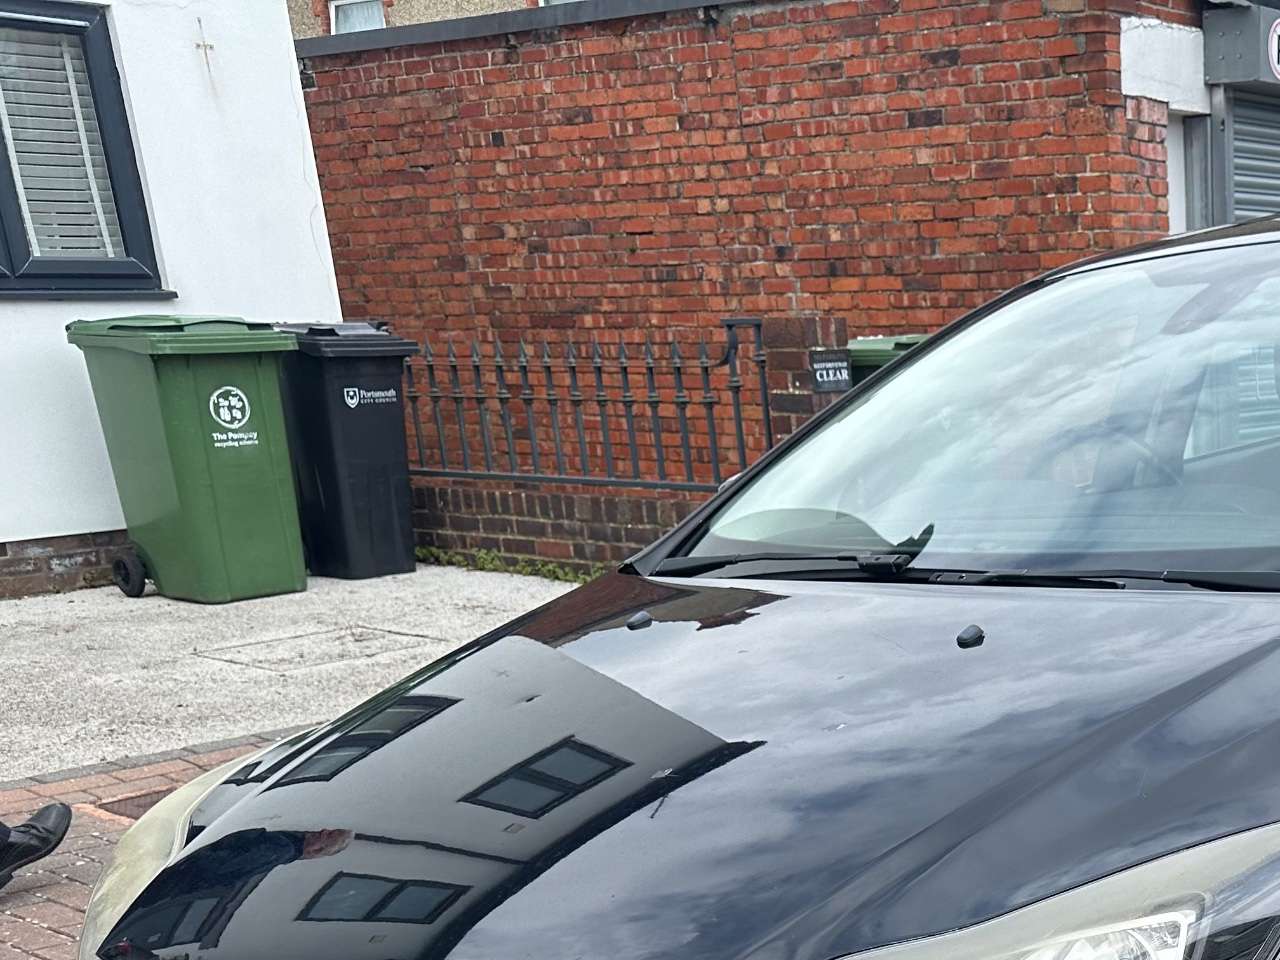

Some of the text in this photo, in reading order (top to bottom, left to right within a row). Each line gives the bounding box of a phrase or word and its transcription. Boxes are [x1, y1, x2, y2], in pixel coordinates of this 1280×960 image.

[815, 368, 849, 382] CLEAR
[360, 388, 397, 399] Portsmouth
[212, 432, 228, 441] The
